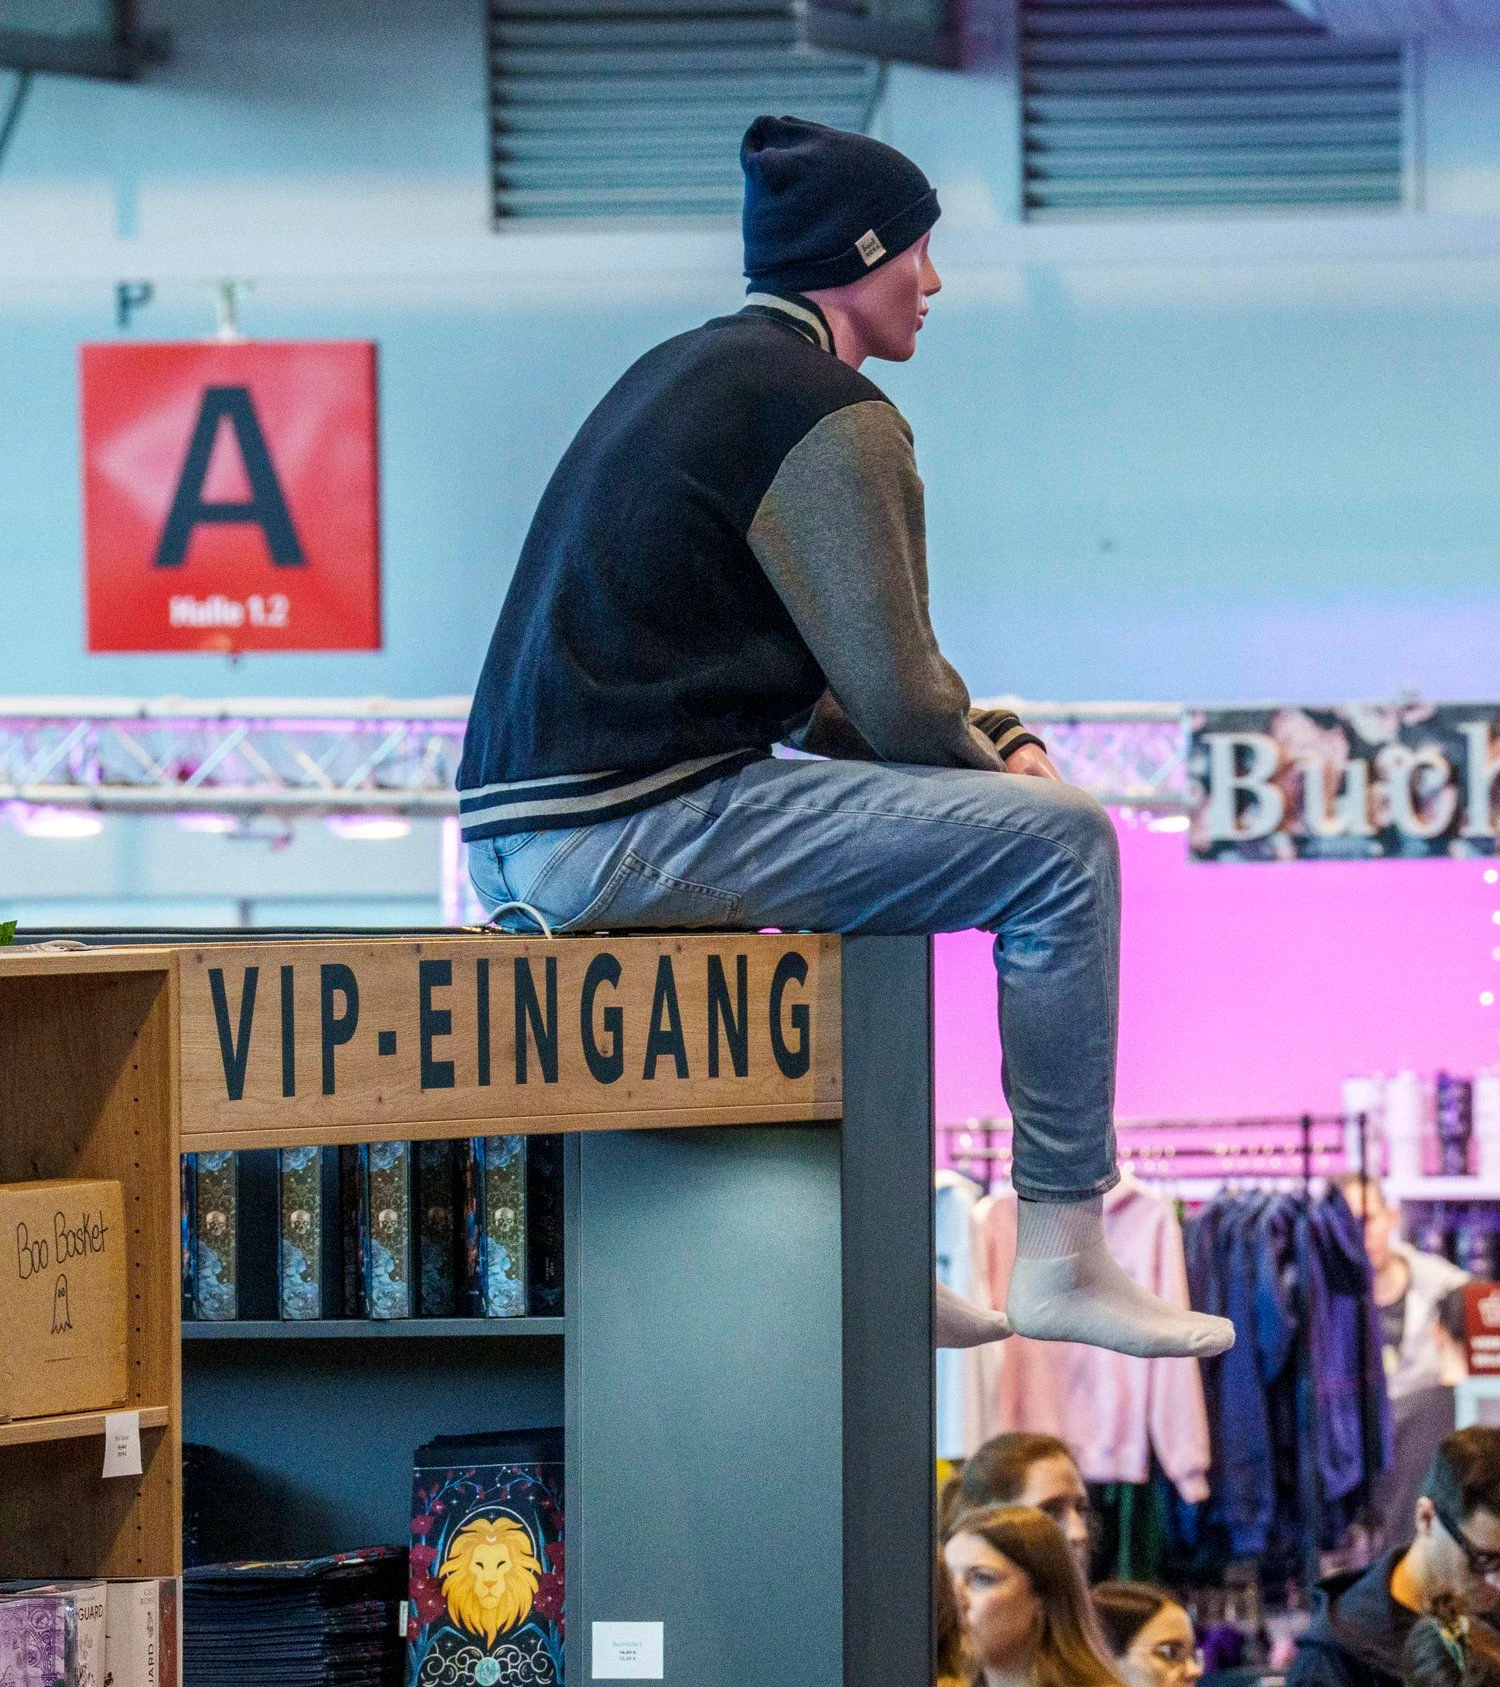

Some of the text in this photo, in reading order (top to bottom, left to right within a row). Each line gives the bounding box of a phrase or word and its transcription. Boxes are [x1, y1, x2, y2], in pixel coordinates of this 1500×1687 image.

[152, 385, 309, 568] A
[209, 951, 811, 1100] VIP-EINGANG
[17, 1210, 108, 1279] Boo Basket
[78, 1604, 103, 1621] GUARD
